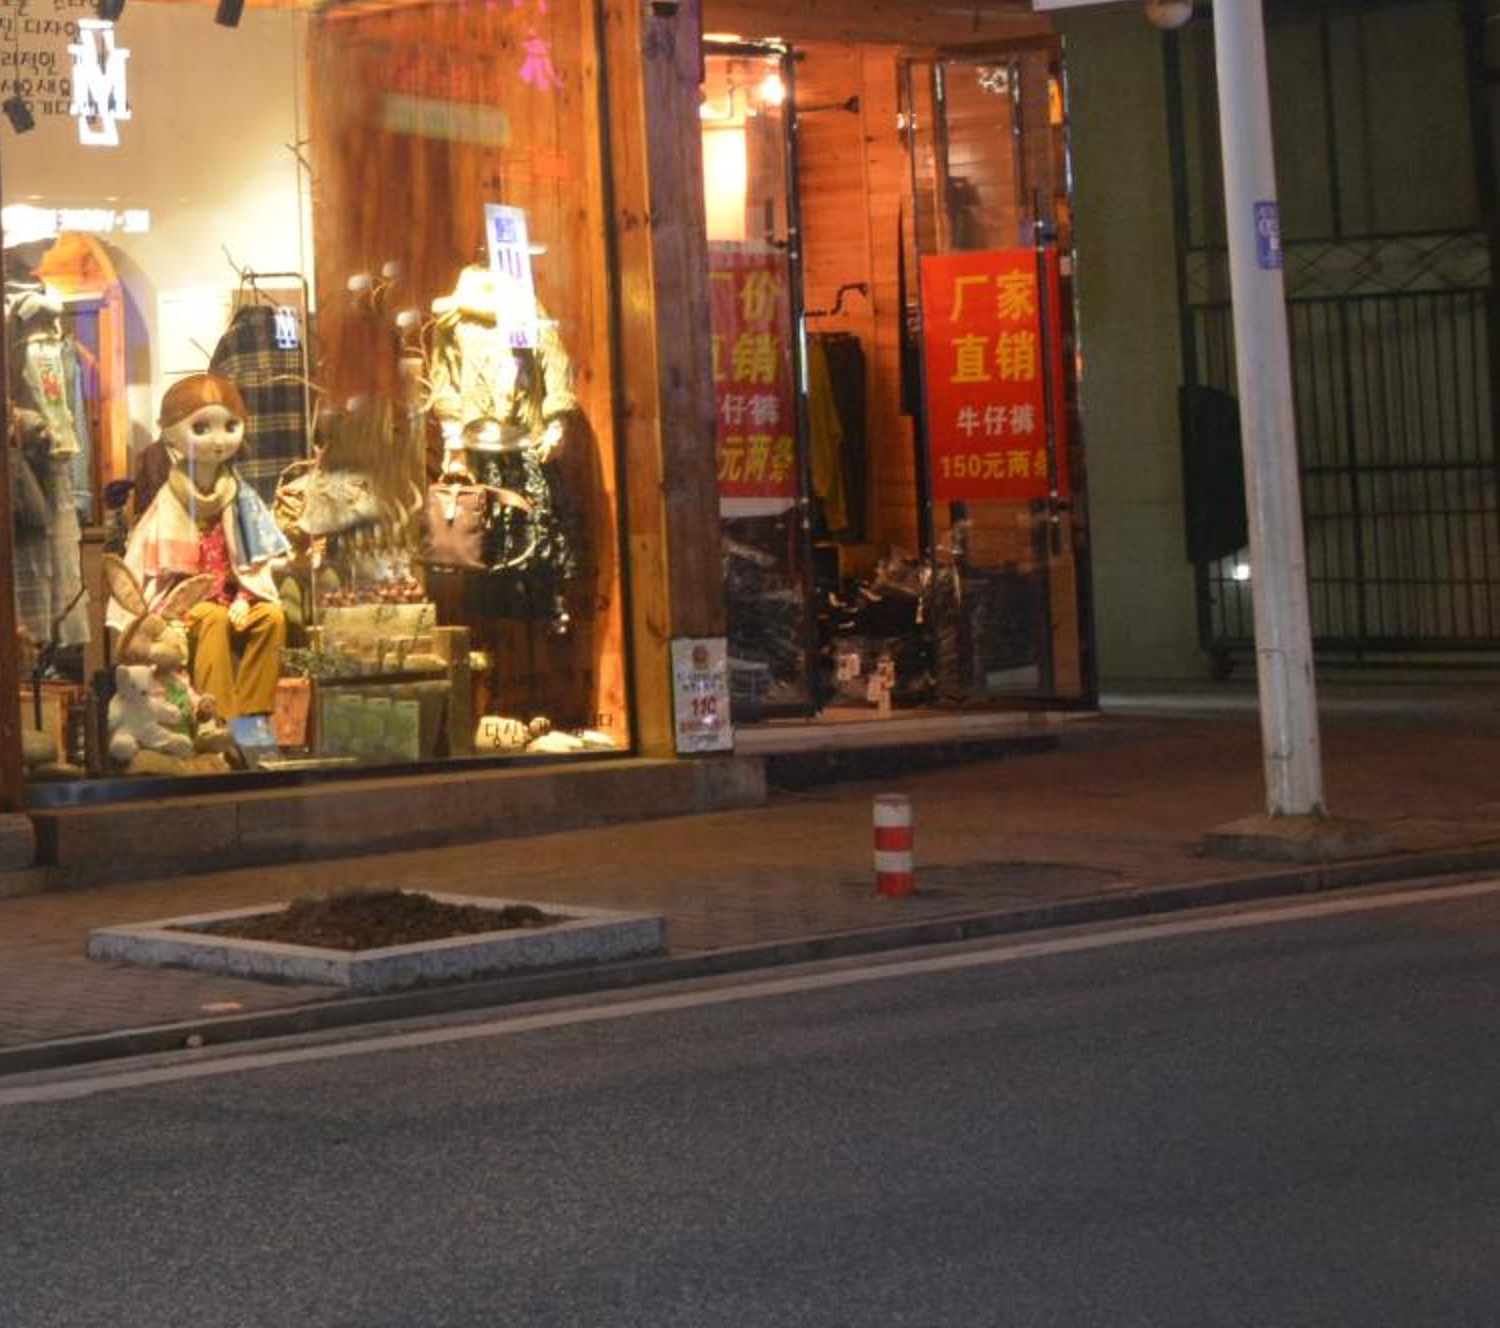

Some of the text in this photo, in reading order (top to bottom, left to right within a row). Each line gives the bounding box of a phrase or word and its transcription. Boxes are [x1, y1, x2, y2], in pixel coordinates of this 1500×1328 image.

[950, 269, 1035, 323] 厂家
[950, 330, 1037, 383] 直销
[956, 404, 1036, 437] 牛仔裤
